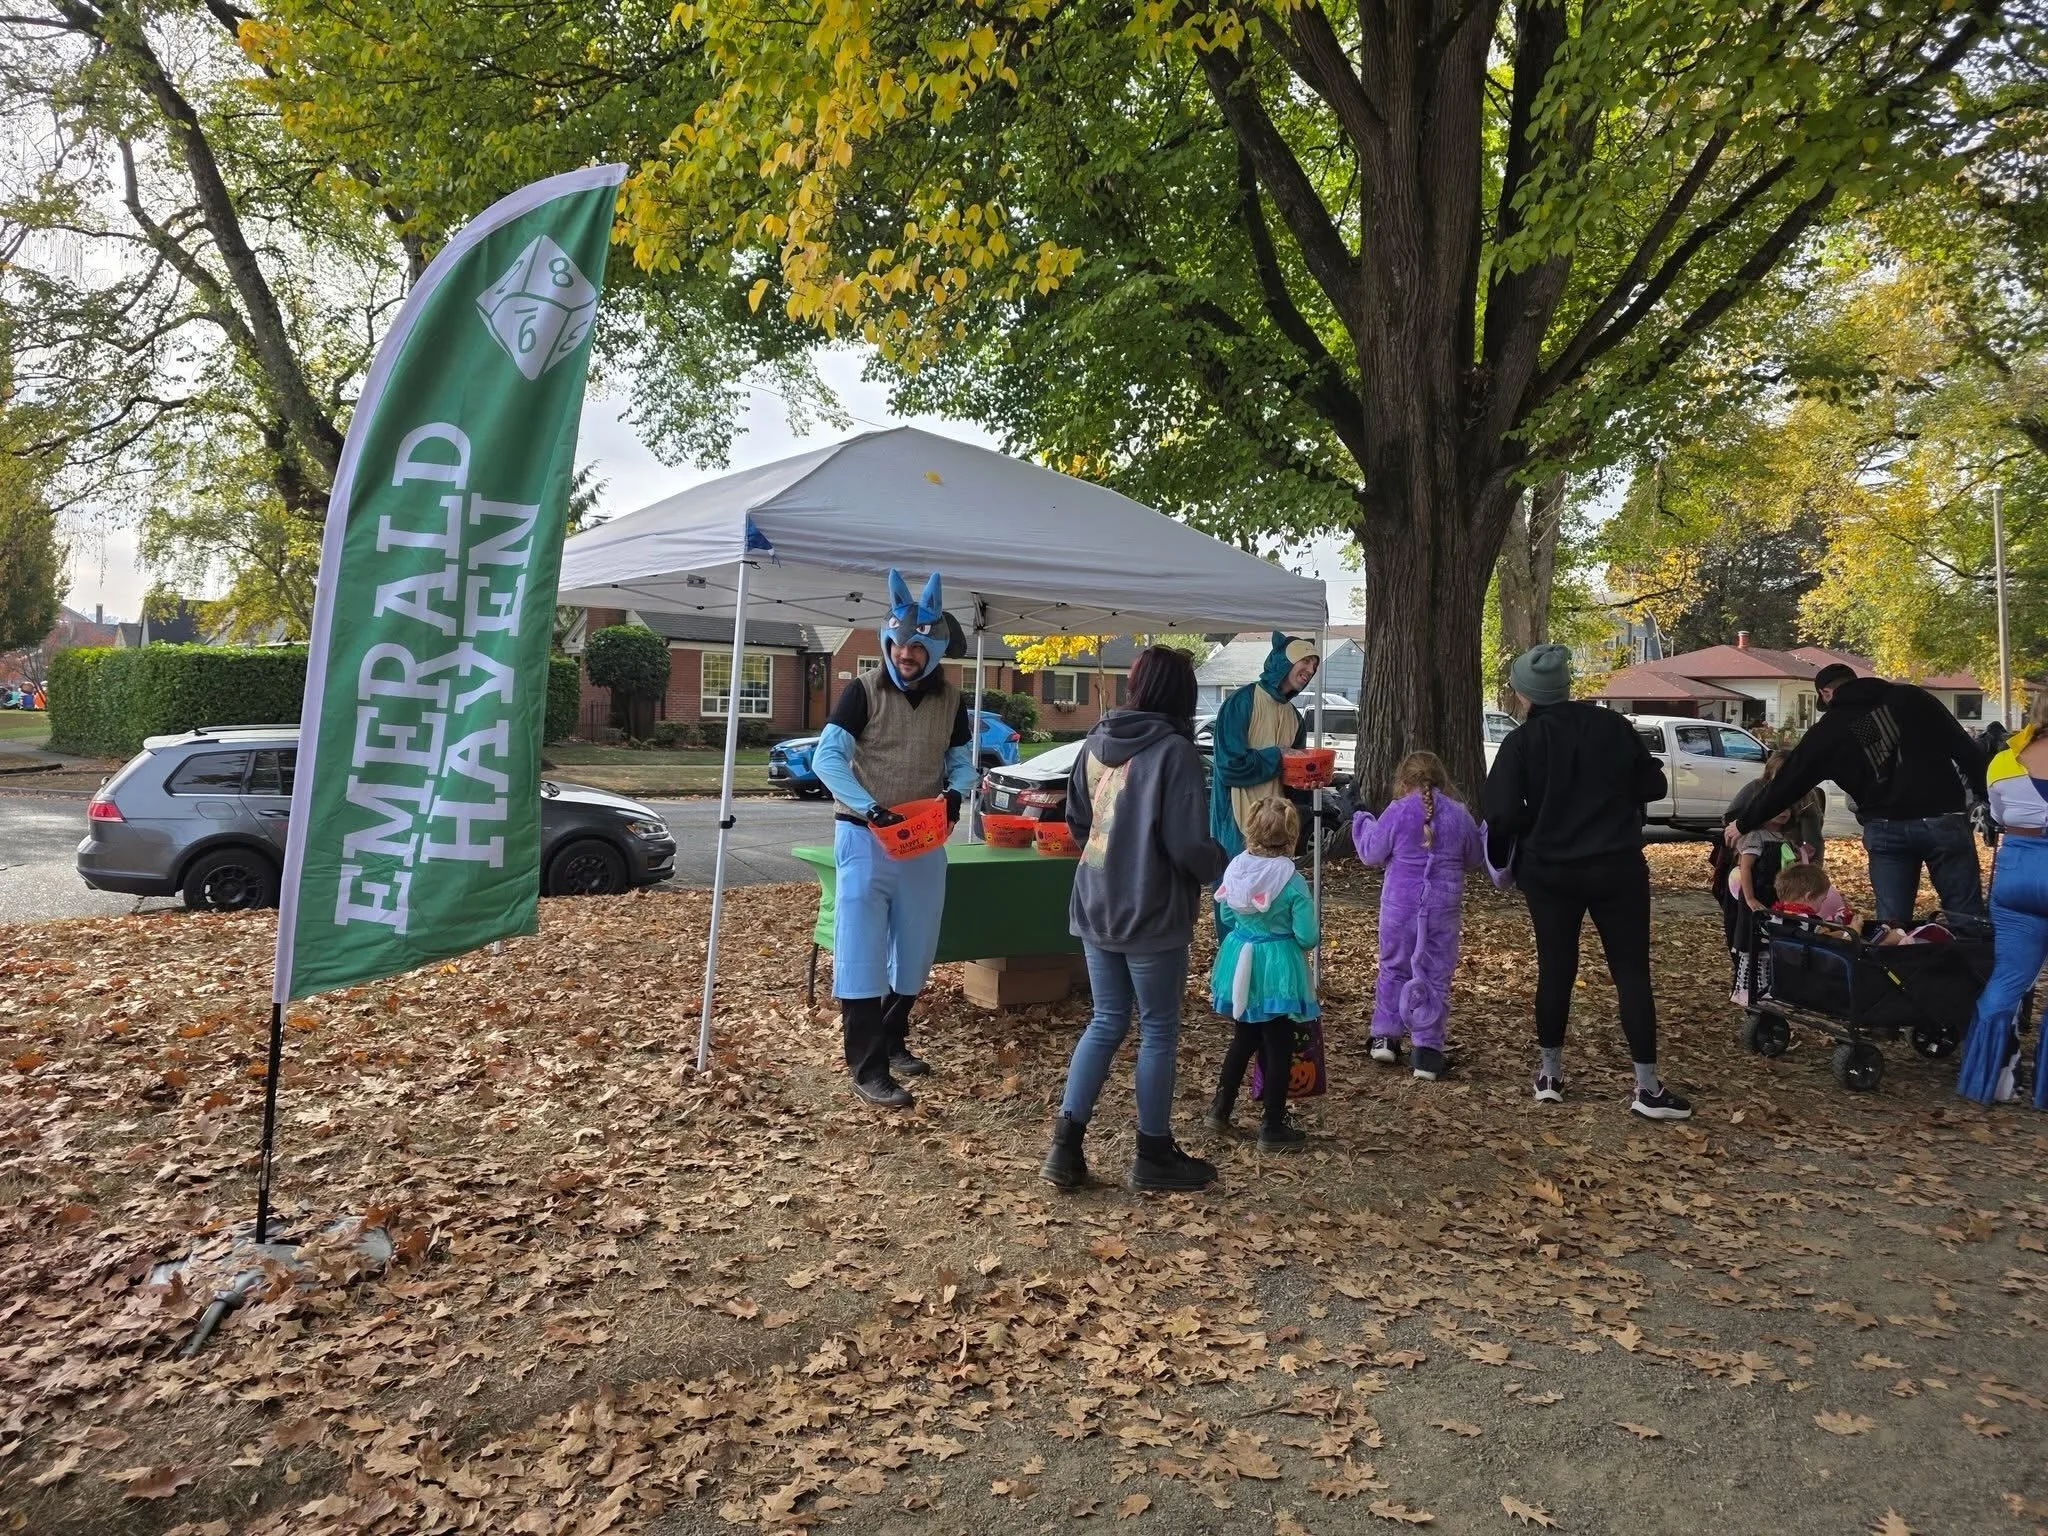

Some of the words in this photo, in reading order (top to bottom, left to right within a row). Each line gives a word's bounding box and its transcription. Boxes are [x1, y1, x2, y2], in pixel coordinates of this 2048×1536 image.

[548, 257, 574, 288] 8
[335, 421, 471, 935] EMERALD
[420, 493, 540, 868] HAVEN
